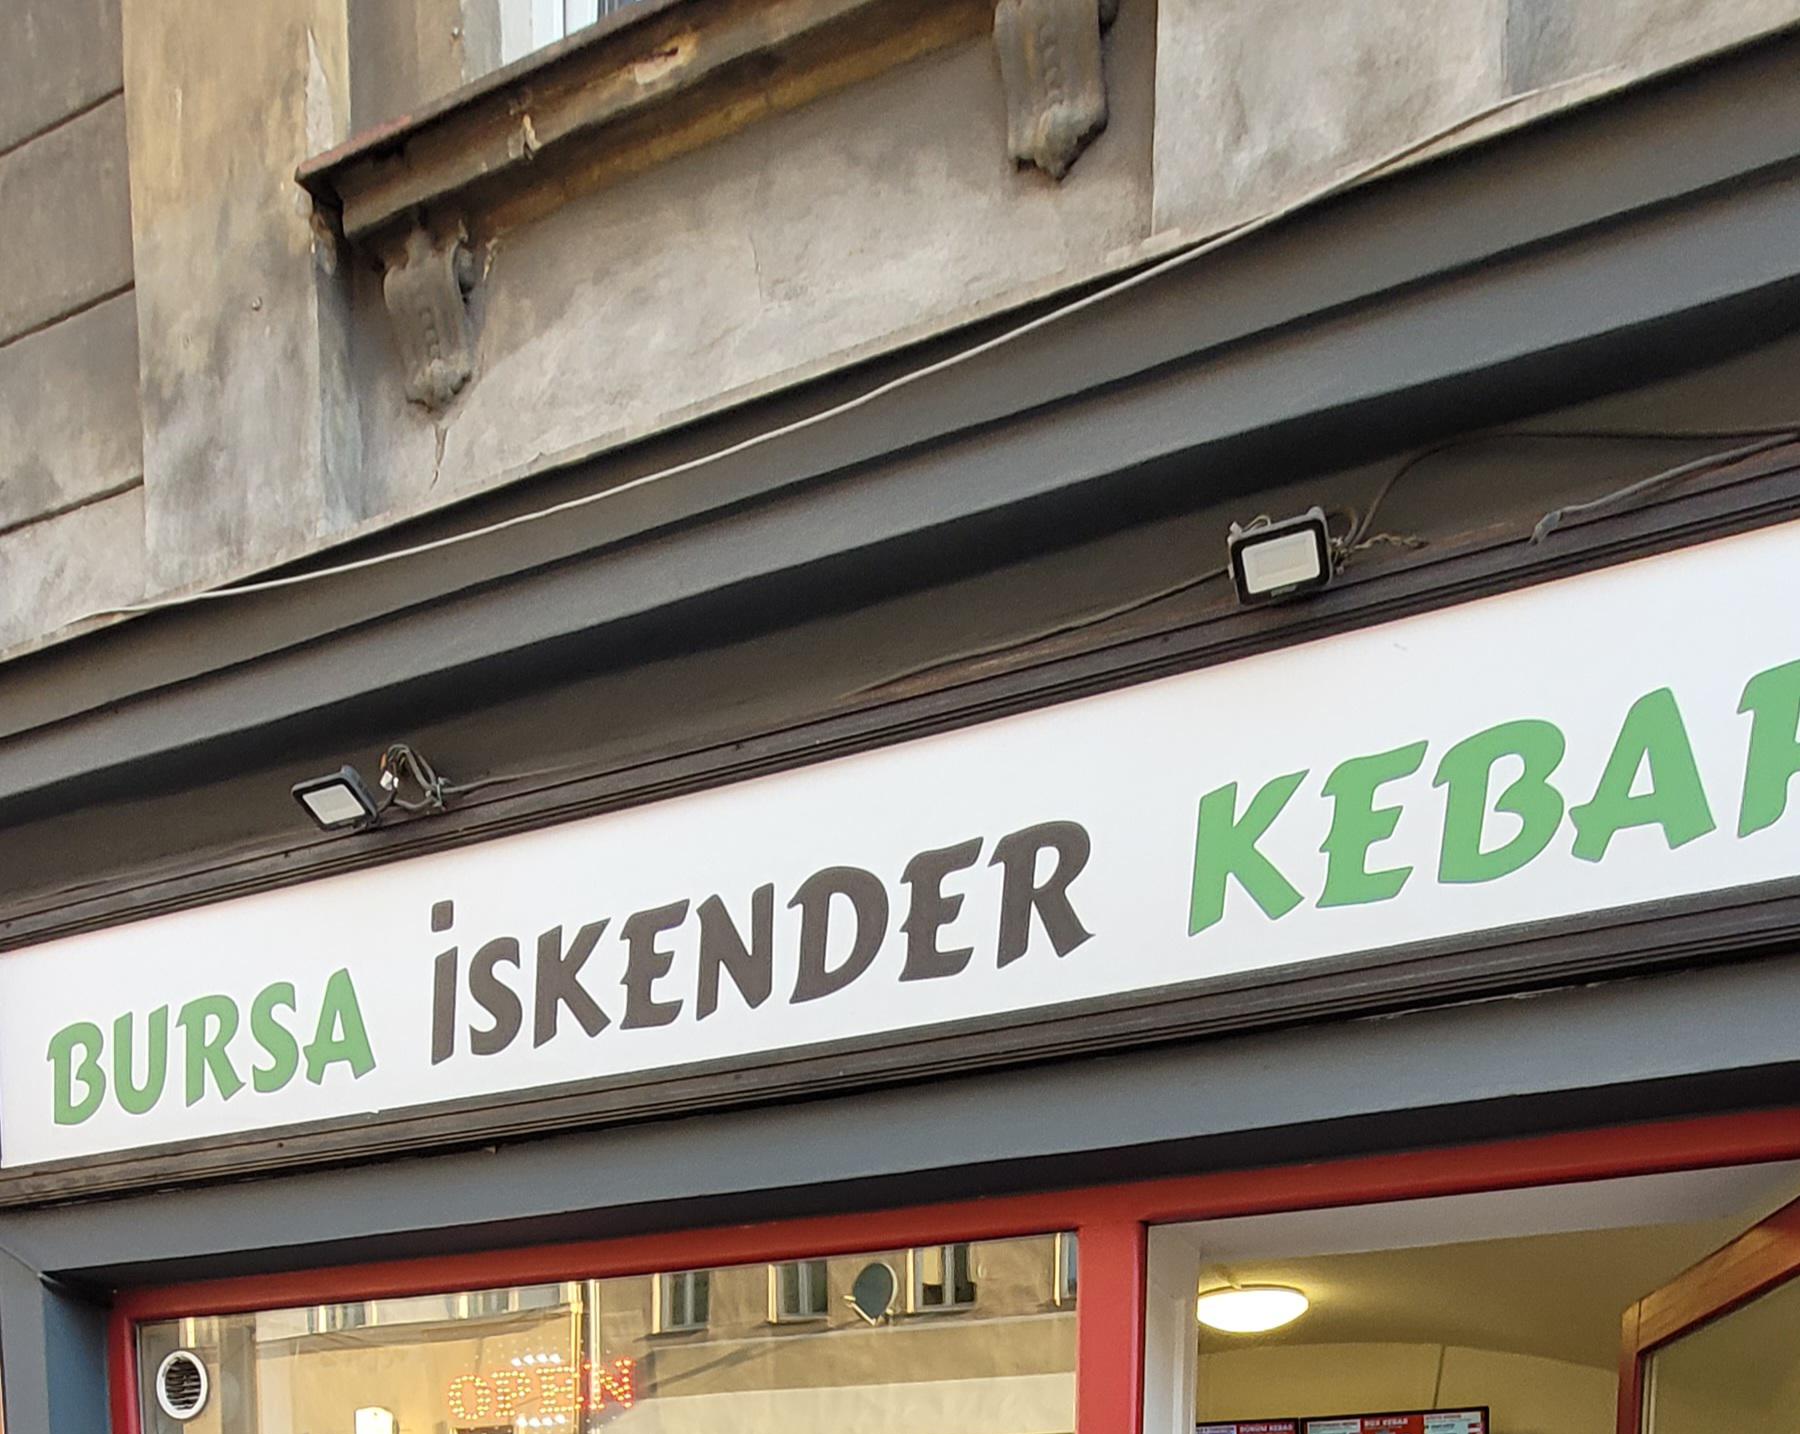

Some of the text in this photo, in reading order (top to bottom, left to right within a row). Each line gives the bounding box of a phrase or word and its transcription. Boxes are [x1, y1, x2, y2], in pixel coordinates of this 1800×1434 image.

[47, 968, 376, 1125] BURSA
[431, 820, 1094, 1066] İSKENDER
[448, 1358, 635, 1420] OPEN
